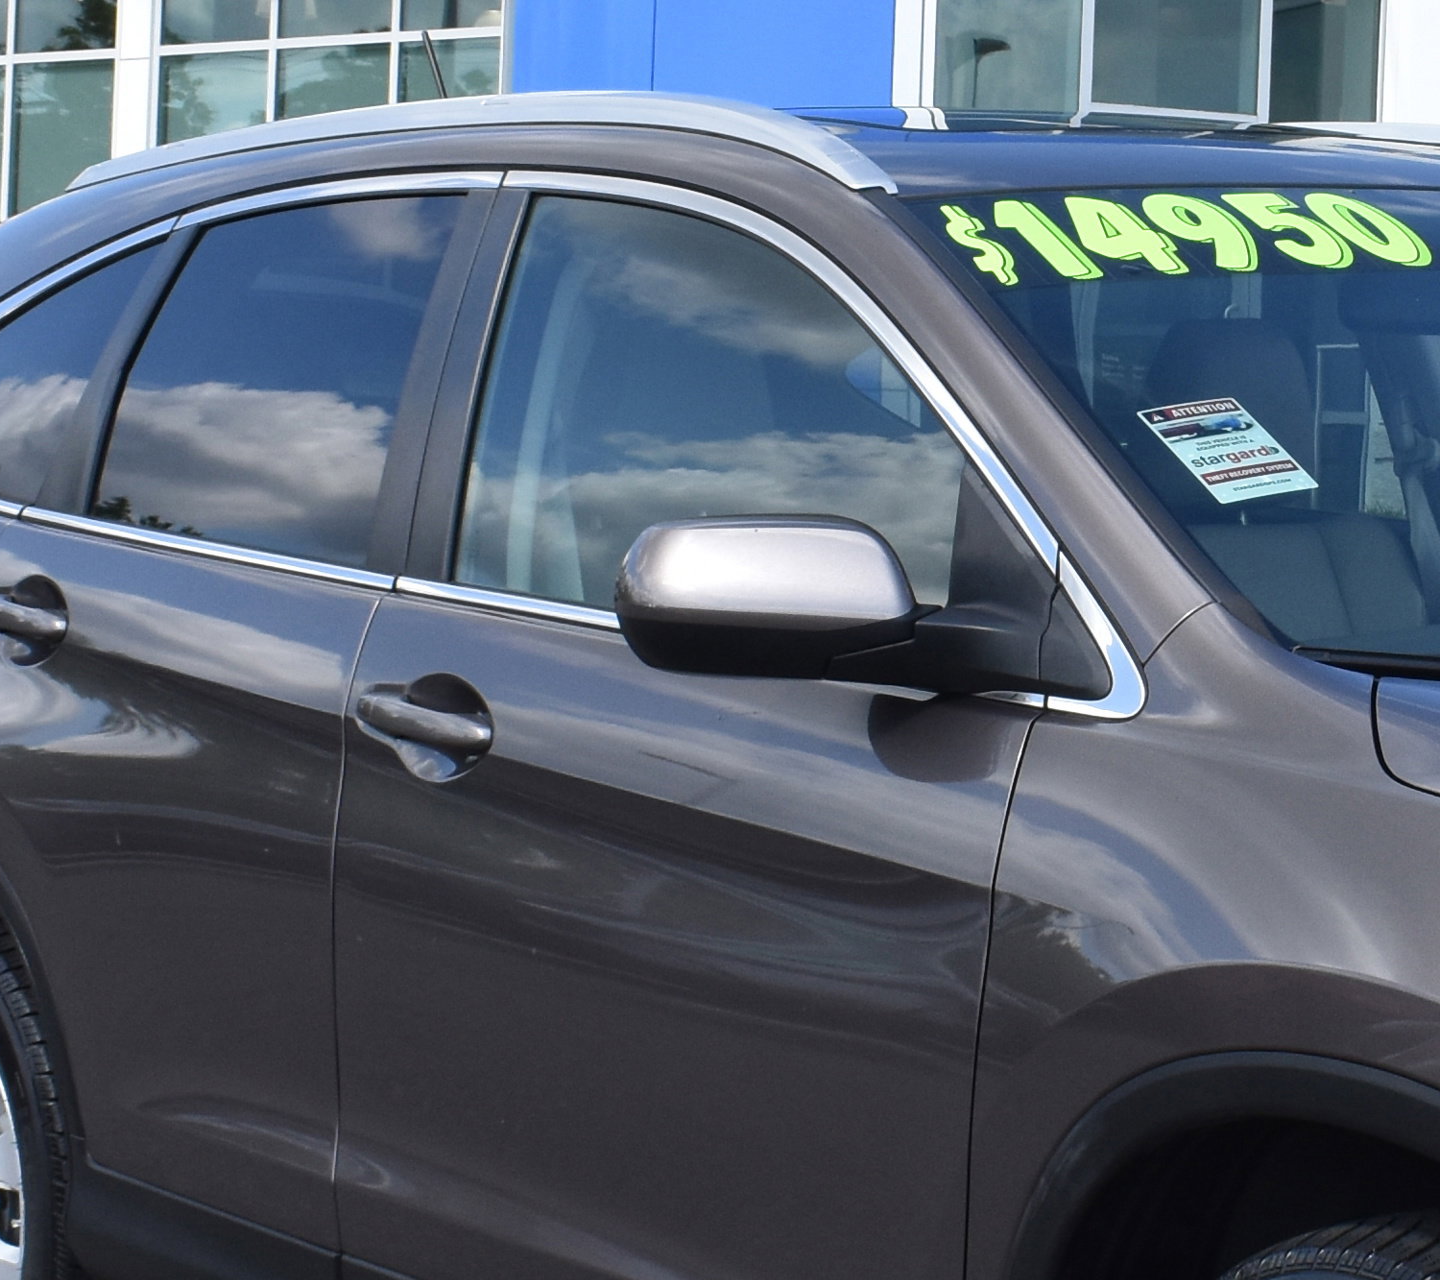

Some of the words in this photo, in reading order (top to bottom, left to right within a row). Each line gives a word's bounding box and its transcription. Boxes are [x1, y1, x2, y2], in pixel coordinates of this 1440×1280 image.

[940, 192, 1433, 286] $14950
[1171, 402, 1236, 418] ATTENTION
[1191, 445, 1269, 468] stargard
[1206, 472, 1229, 483] THEFT
[1228, 466, 1266, 479] RECOVERY
[1265, 462, 1295, 472] SYSTEM
